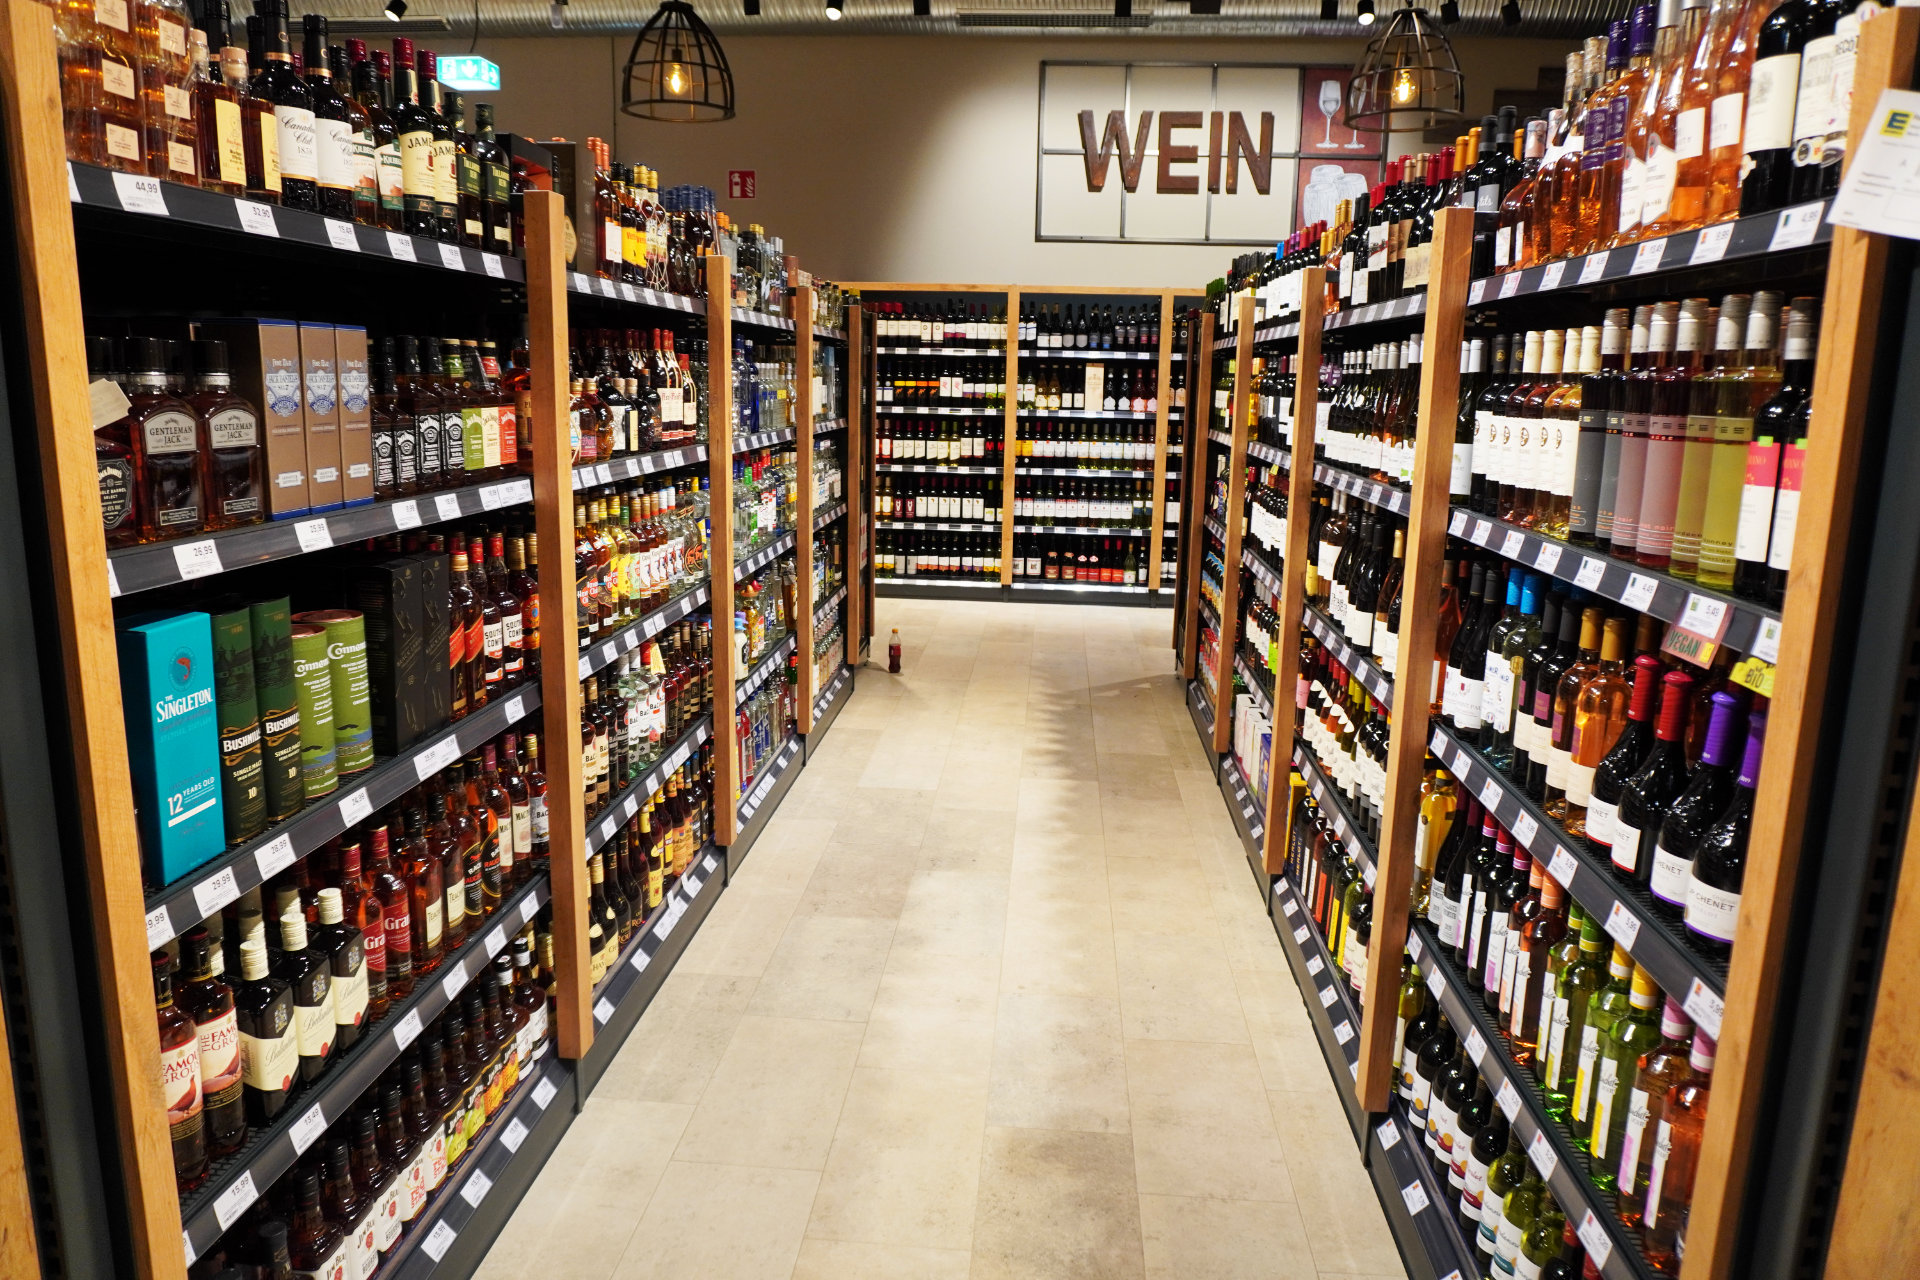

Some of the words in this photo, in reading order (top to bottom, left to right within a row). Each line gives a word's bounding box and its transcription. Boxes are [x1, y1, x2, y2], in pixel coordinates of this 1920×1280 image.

[1887, 112, 1910, 130] E
[1077, 109, 1275, 195] WEIN
[135, 181, 158, 194] 44,99
[149, 425, 193, 436] GENTLEMAN
[213, 422, 253, 432] GENTLEMAN
[226, 431, 243, 440] JACK
[163, 435, 181, 444] JACK
[193, 545, 213, 557] 26,99
[1666, 629, 1702, 657] VEGAN
[1744, 668, 1765, 689] BIO
[156, 687, 214, 723] SINGLETON
[165, 694, 174, 702] THE
[288, 766, 296, 779] 10
[182, 782, 203, 797] YEARS
[203, 776, 215, 788] OLD
[248, 786, 258, 800] 10
[167, 793, 184, 816] 12
[212, 872, 231, 892] 29,99
[1694, 893, 1736, 912] CHENET
[201, 1032, 211, 1054] THE
[231, 1176, 249, 1197] 15,99
